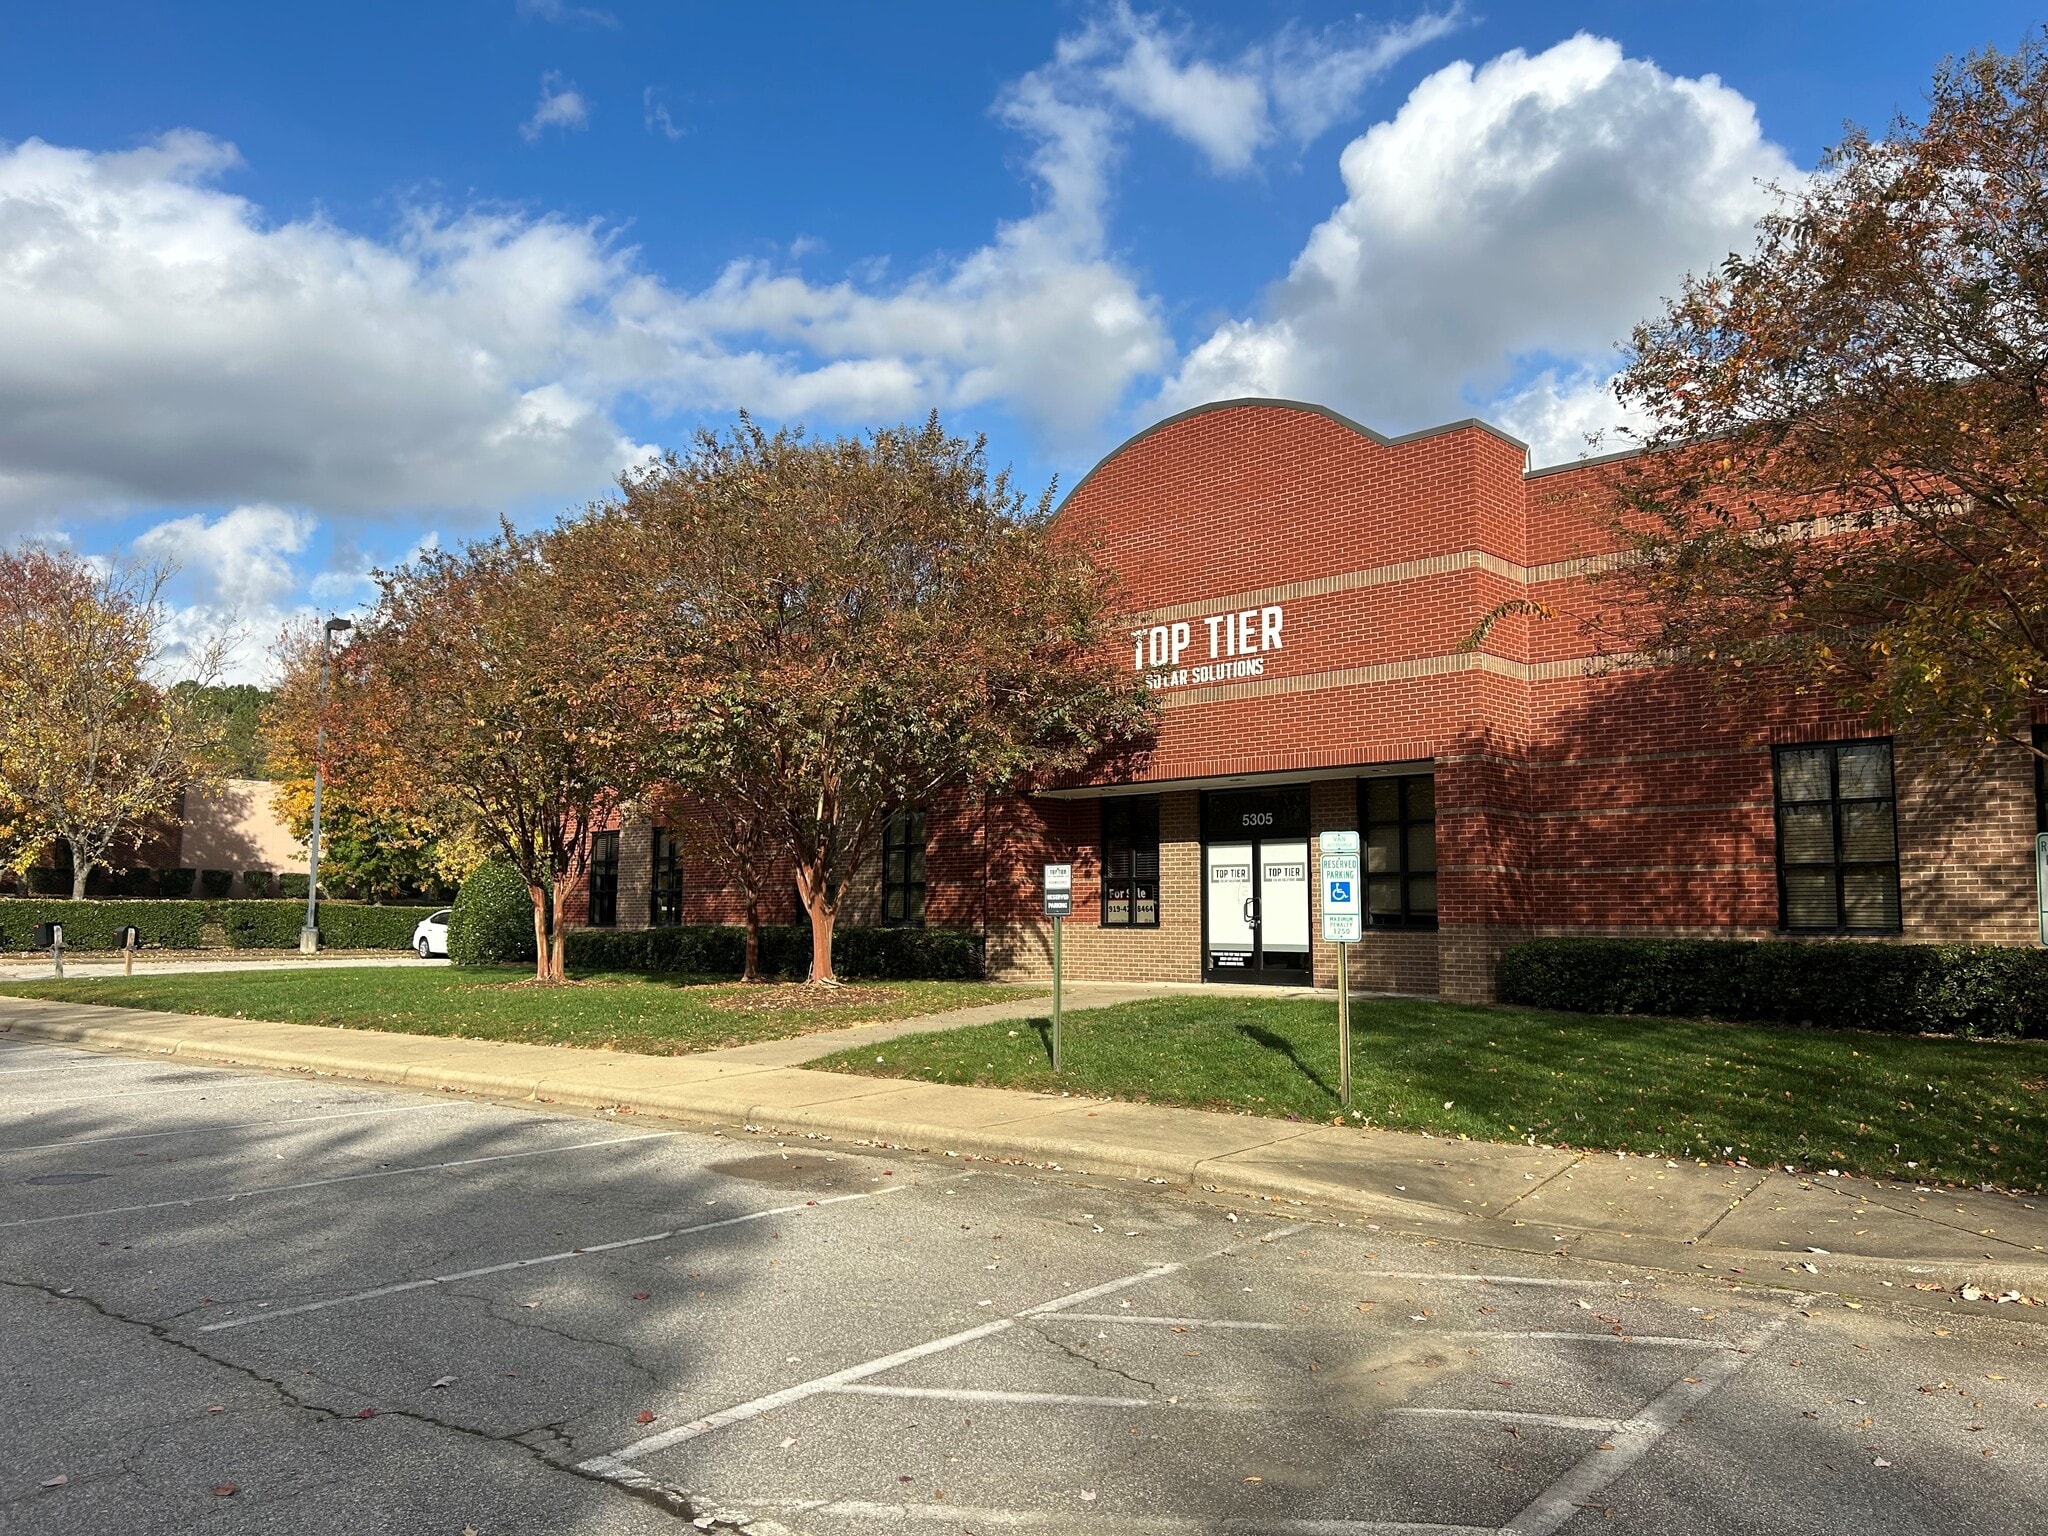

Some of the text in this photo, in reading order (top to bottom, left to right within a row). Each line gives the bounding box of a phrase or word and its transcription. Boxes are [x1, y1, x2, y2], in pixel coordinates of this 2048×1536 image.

[1131, 605, 1283, 670] TOP TIER
[1192, 658, 1264, 683] SOLUTIONS
[1242, 813, 1273, 826] 5305
[1323, 860, 1357, 869] RESERVED
[1216, 869, 1246, 878] TOP TIER
[1268, 867, 1300, 877] TOP TIER
[1326, 870, 1354, 879] PARKING
[1109, 887, 1146, 898] For Sle
